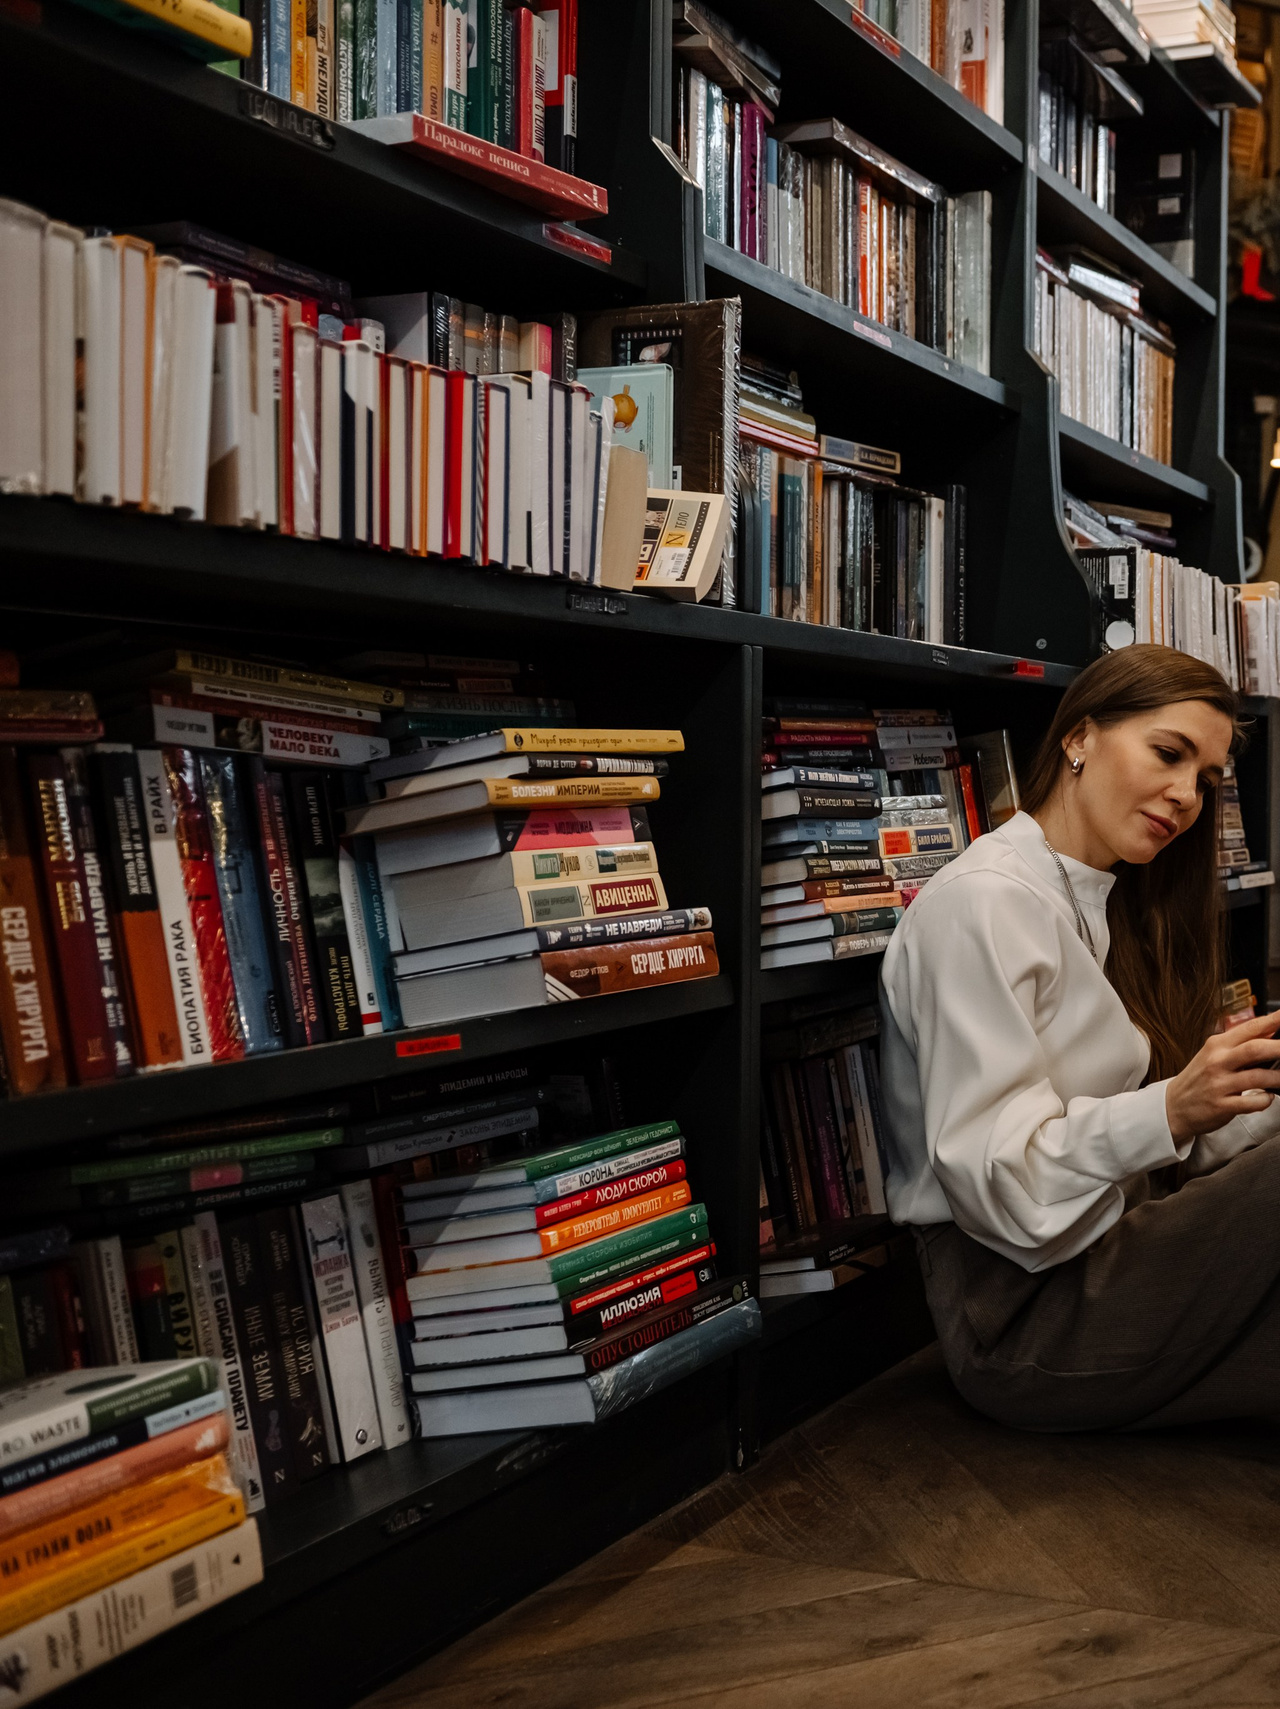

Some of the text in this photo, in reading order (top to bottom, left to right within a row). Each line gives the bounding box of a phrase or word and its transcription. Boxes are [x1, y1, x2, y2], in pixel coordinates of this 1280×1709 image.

[275, 25, 288, 52] ДНК
[504, 19, 513, 81] Картинки
[534, 64, 545, 101] ДИАЛОГ
[504, 94, 513, 136] голове
[534, 113, 545, 146] ТЕЛОМ
[424, 122, 530, 178] Парадокс пениса
[762, 452, 772, 503] ВОЗДУХ
[675, 511, 690, 531] ТЕЛО
[434, 697, 480, 711] ЖИЗНЬ
[268, 726, 334, 745] ЧЕЛОВЕКУ
[270, 739, 341, 759] МАЛО ВЕКА
[530, 733, 557, 748] Микроб
[144, 775, 169, 836] В.РАЙХ
[512, 785, 556, 799] БОЛЕЗНИ
[557, 784, 600, 797] ИМПЕРИИ
[113, 797, 132, 853] ПРИЗВАНИЕ
[305, 786, 324, 846] ШЕРИ ФИНК
[917, 835, 930, 846] БИЛЛ
[930, 832, 951, 844] БРАЙСОН
[124, 865, 139, 895] ЖИЗНЬ
[136, 853, 151, 894] ДОКТОРА
[84, 852, 114, 961] НЕ НАВРЕДИ
[270, 868, 292, 943] ЛИЧНОСТЬ
[286, 881, 303, 922] ОЧЕРКИ
[366, 861, 387, 940] ДОЛГ СЕРДЦА
[595, 884, 655, 908] АВИЦЕННА
[605, 917, 663, 936] НЕ НАВРЕДИ
[849, 939, 870, 950] ПОВЕРЬ
[296, 924, 315, 987] ЛИТВИНОВА
[569, 965, 609, 979] ФЕДОР УГЛОВ
[631, 945, 706, 975] СЕРДЦЕ ХИРУРГА
[3, 906, 50, 1063] СЕРДЦЕ ХИРУРГА
[168, 919, 205, 1056] БИОПАТИЯ РАКА
[339, 954, 357, 1007] ПЯТЬ ДНЕЙ
[305, 987, 317, 1023] ФЛОРА
[328, 967, 349, 1032] КАТАСТРОФЫ
[440, 1067, 528, 1094] ЭПИДЕМИИ И НАРОДЫ
[422, 1101, 497, 1123] СМЕРТЕЛЬНЫЕ СПУТНИКИ
[459, 1114, 532, 1138] ЗАКОНЫ ЭПИДЕМИЙ
[626, 1125, 674, 1146] ЗЕЛЕНЫЙ ГЕДОНИСТ
[568, 1152, 593, 1164] АЛЕКСАНДР
[195, 1179, 307, 1207] ДНЕВНИК ВОЛОНТЕРКИ
[579, 1166, 615, 1188] КОРОНА,
[595, 1166, 668, 1204] ЛЮДИ СКОРОЙ
[139, 1200, 185, 1217] COVID-19
[573, 1196, 662, 1239] НЕВЕРОЯТНЫЙ ИММУНИТЕТ
[313, 1253, 350, 1278] ИСПАНКА
[558, 1257, 585, 1271] ТЕМНАЯ
[586, 1244, 618, 1264] СТОРОНА
[619, 1231, 653, 1251] ИЗОБИЛИЯ
[367, 1257, 386, 1314] ВЫЖИТЬ
[600, 1286, 662, 1323] ИЛЛЮЗИЯ
[602, 1299, 663, 1331] БЕЗОПАСНОСТИ
[168, 1291, 198, 1357] ВИРУ
[290, 1304, 314, 1376] ИСТОРИЯ
[591, 1309, 693, 1369] ОПУСТОШИТЕЛЬ
[213, 1297, 250, 1432] СПАСАЮТ ПЛАНЕТУ
[244, 1304, 276, 1403] ИНЫЕ ЗЕМЛИ
[30, 1415, 81, 1445] WASTE
[26, 1536, 71, 1567] ГРАНИ
[75, 1515, 113, 1545] ФОЛА
